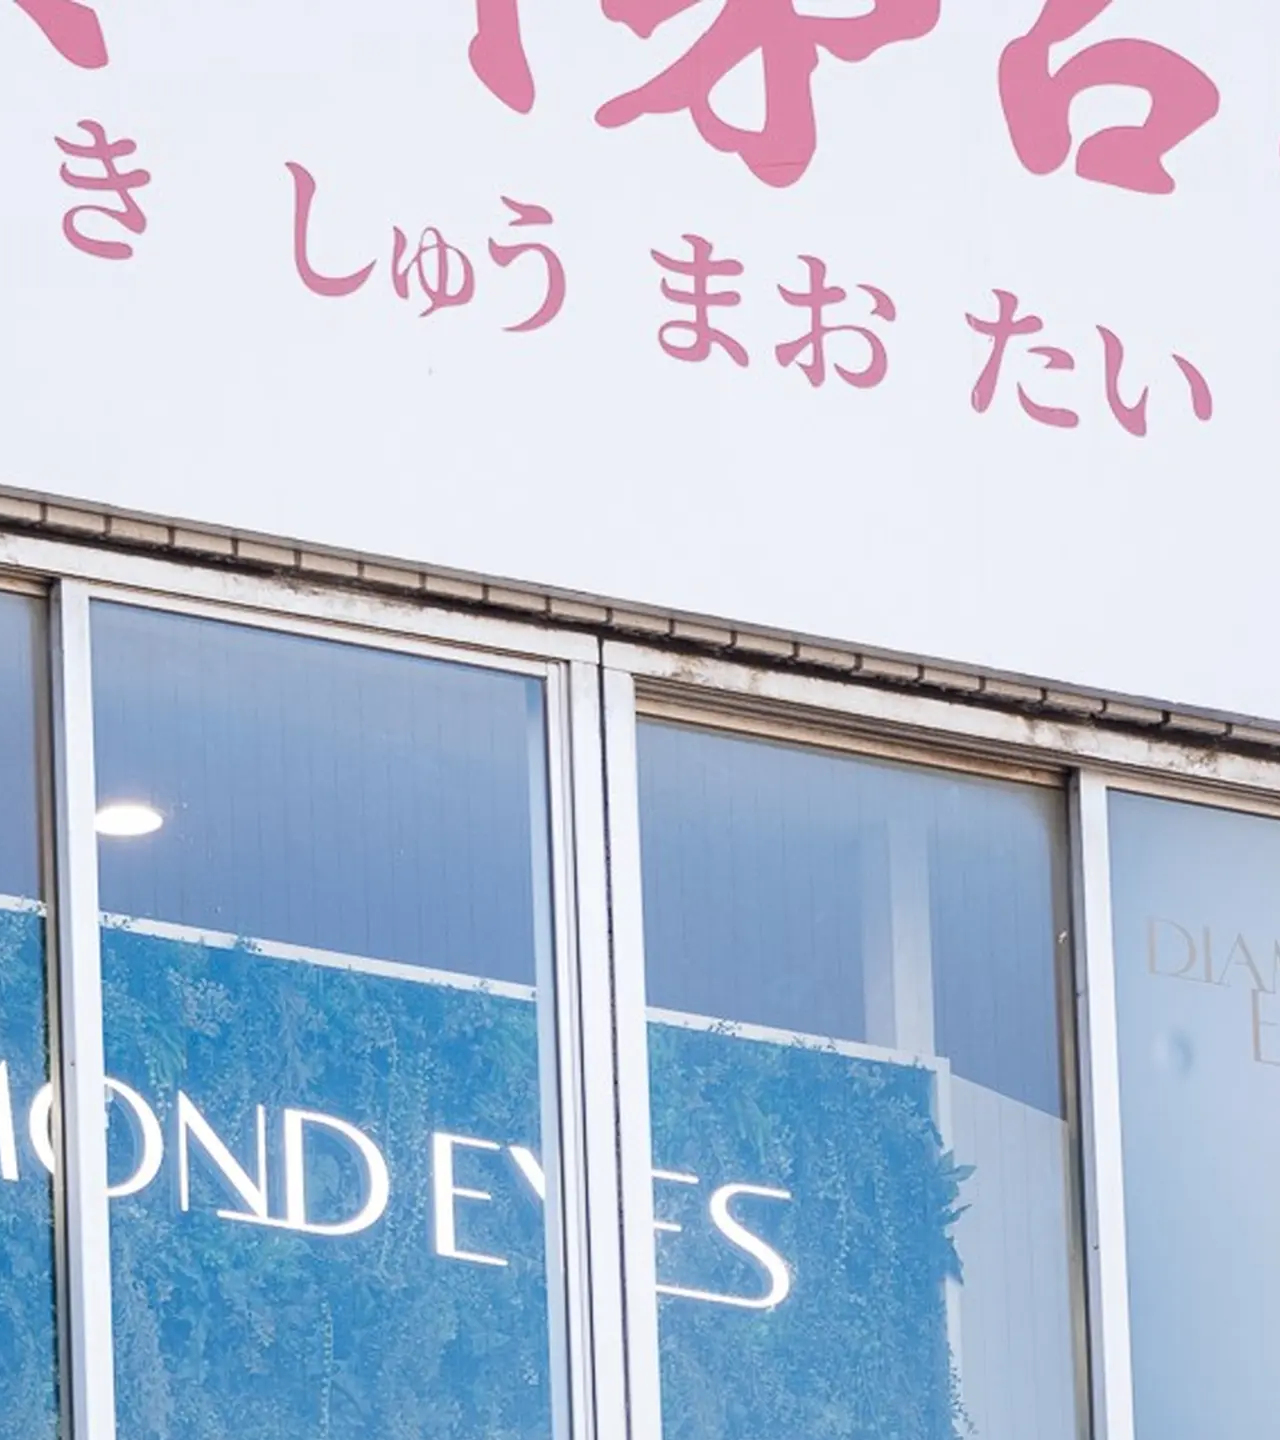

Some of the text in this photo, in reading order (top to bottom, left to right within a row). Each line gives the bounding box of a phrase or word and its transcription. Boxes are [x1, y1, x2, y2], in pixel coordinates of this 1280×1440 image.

[55, 119, 151, 260] き
[286, 162, 566, 331] しゅう
[651, 234, 897, 388] まお
[965, 289, 1214, 436] たい
